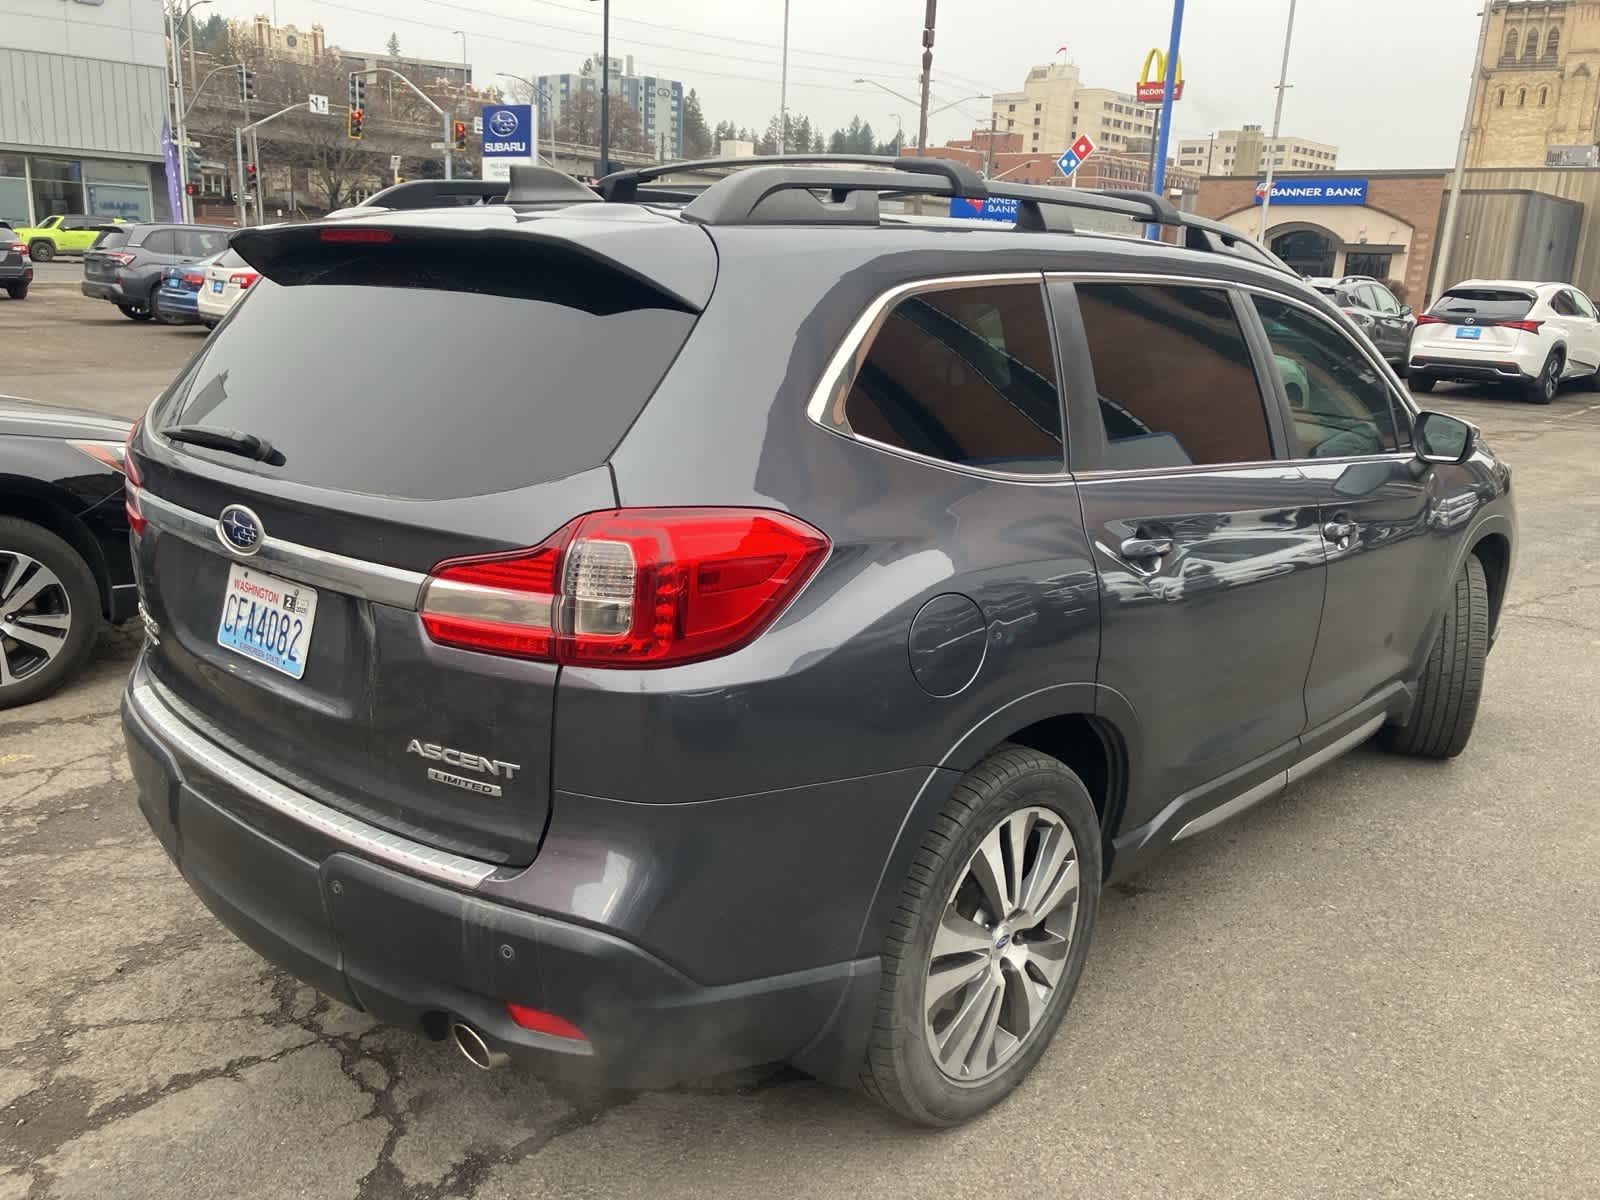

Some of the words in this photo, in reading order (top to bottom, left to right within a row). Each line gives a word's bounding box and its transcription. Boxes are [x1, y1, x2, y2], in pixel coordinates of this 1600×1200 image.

[1140, 88, 1179, 96] McDons
[484, 142, 526, 152] SUBARU
[1270, 187, 1322, 197] BANNER
[1326, 187, 1363, 197] BANK
[988, 205, 1017, 214] BANK
[234, 579, 280, 605] WASHINGTON
[223, 593, 303, 662] CFA4082
[406, 739, 521, 779] ASCENT
[433, 772, 492, 793] LIMITED
